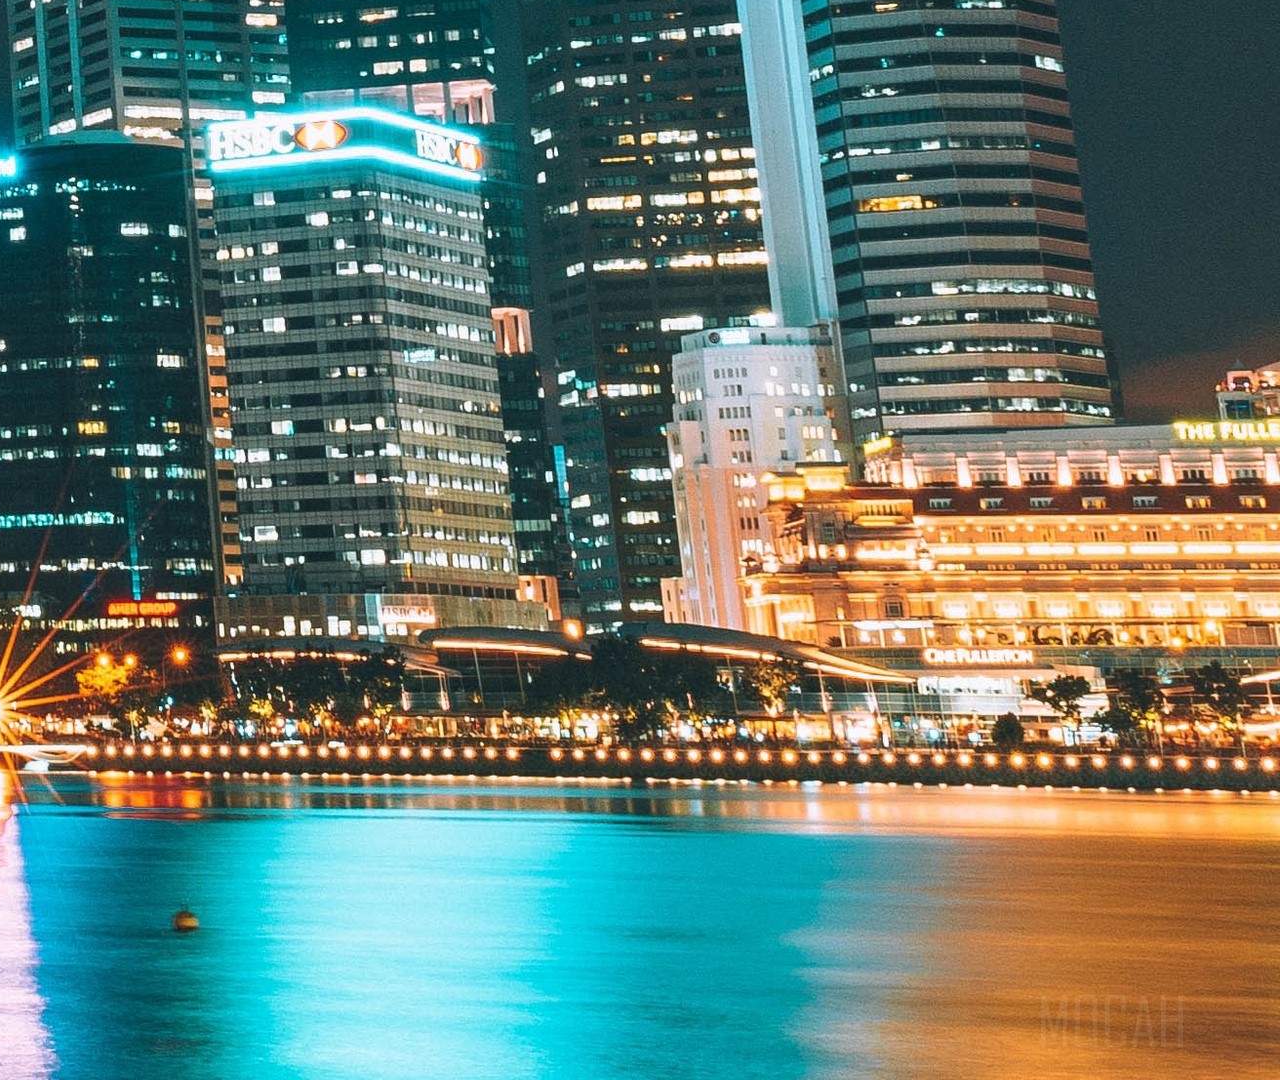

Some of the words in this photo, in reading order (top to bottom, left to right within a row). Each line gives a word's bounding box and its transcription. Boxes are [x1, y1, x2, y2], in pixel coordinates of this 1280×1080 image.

[208, 121, 295, 161] HSBC
[415, 129, 458, 166] HSBC
[1173, 421, 1216, 440] THE
